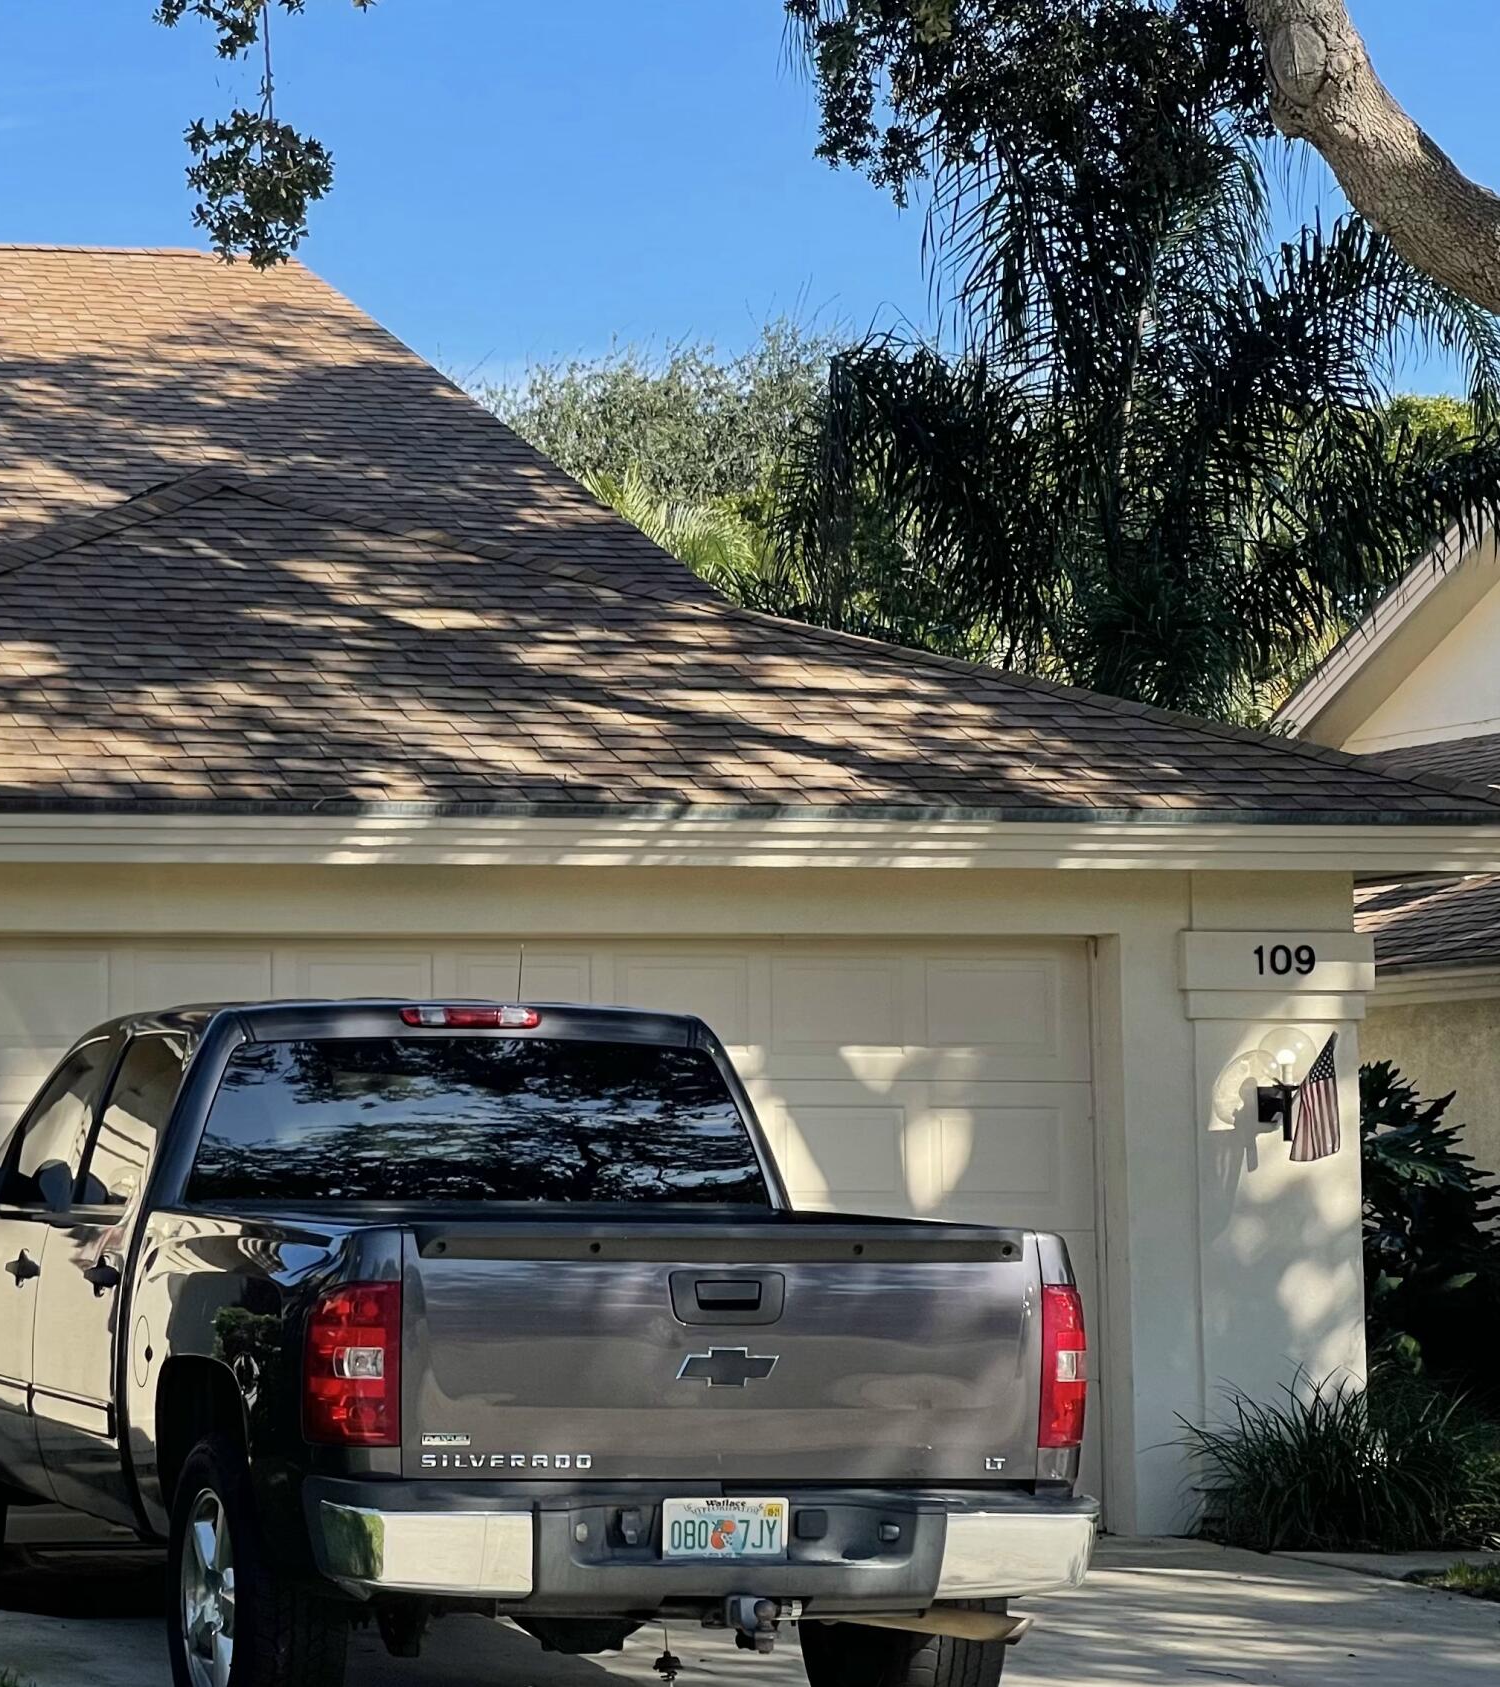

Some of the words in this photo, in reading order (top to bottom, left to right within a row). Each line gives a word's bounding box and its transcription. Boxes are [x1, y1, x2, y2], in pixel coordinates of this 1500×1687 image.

[1253, 944, 1316, 975] 109
[421, 1454, 592, 1468] SILVERADO
[985, 1457, 1006, 1470] LT
[705, 1499, 747, 1507] Wallace
[738, 1519, 777, 1550] 7JY
